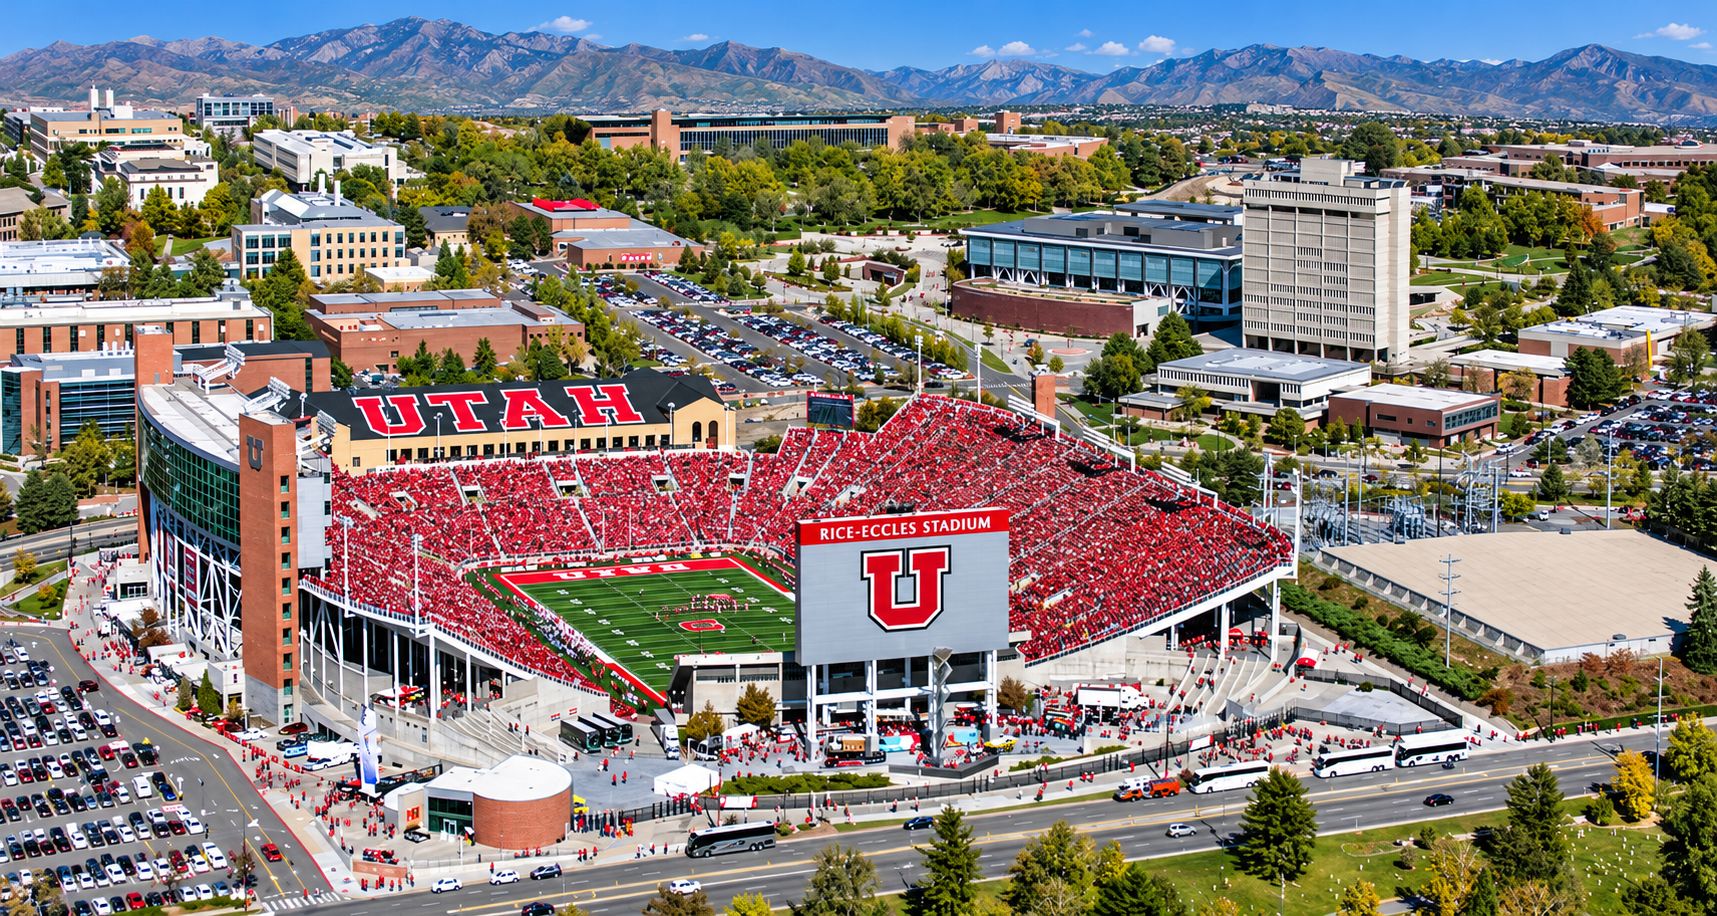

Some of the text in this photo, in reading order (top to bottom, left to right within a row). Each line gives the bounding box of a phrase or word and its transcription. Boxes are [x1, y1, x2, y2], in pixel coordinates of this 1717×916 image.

[351, 383, 646, 437] UTAH
[246, 434, 264, 473] U
[820, 516, 991, 541] RICE-ECCLES STADIUM
[860, 544, 952, 633] U
